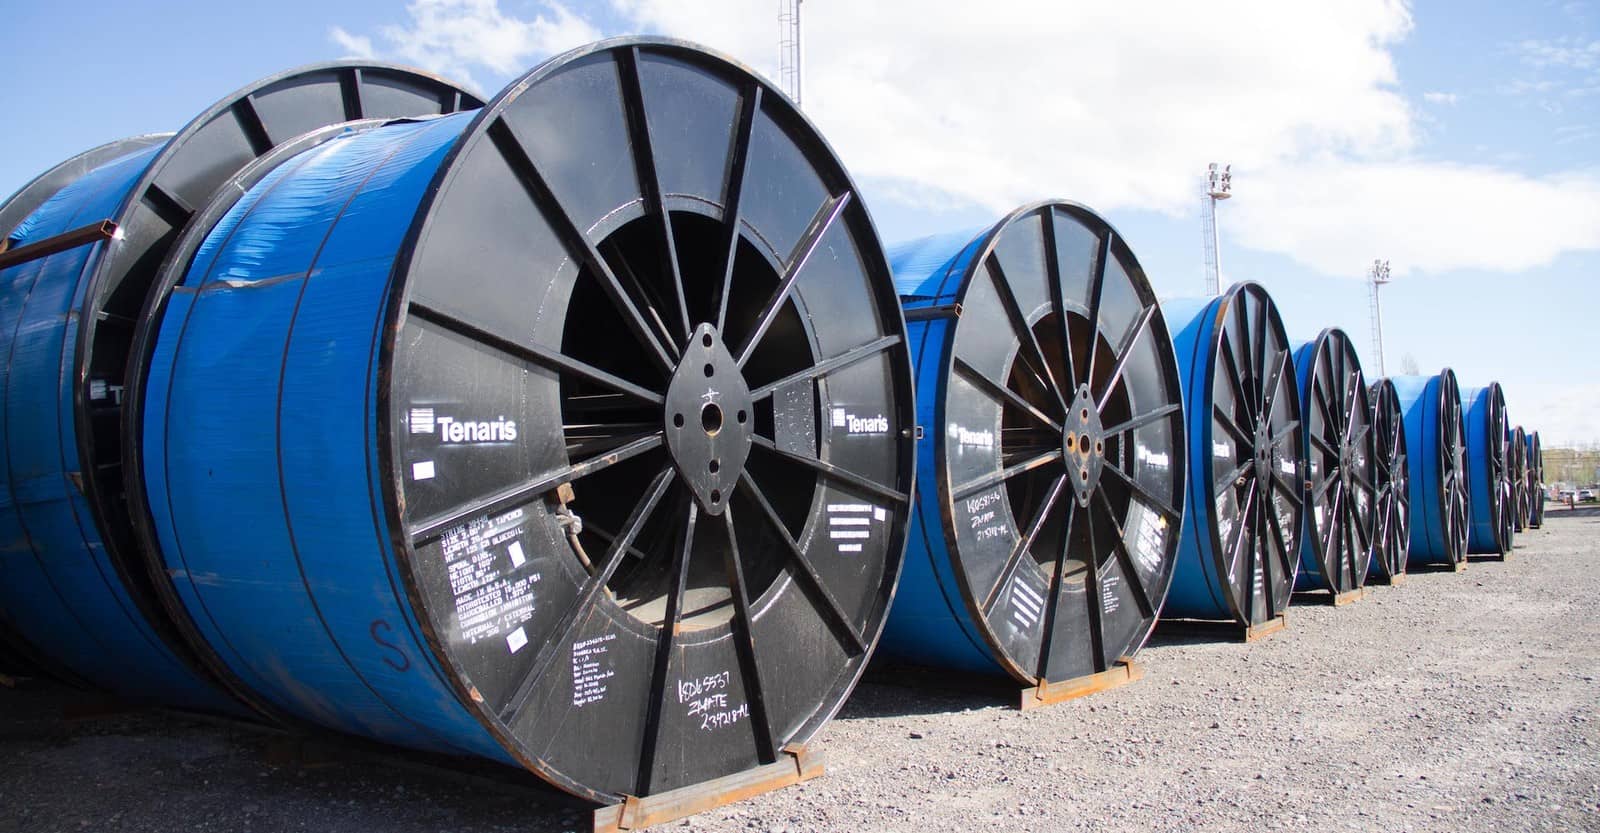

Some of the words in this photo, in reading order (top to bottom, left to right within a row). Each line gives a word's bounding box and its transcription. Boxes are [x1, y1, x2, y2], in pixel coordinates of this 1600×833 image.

[437, 416, 517, 442] Tenaris
[847, 414, 888, 433] Tenaris
[443, 539, 469, 554] LENGTH
[449, 565, 474, 580] HEIGHT
[528, 572, 541, 583] PSI
[451, 574, 473, 587] WIDTH
[453, 580, 479, 595] LENGTH
[455, 593, 473, 605] MADE
